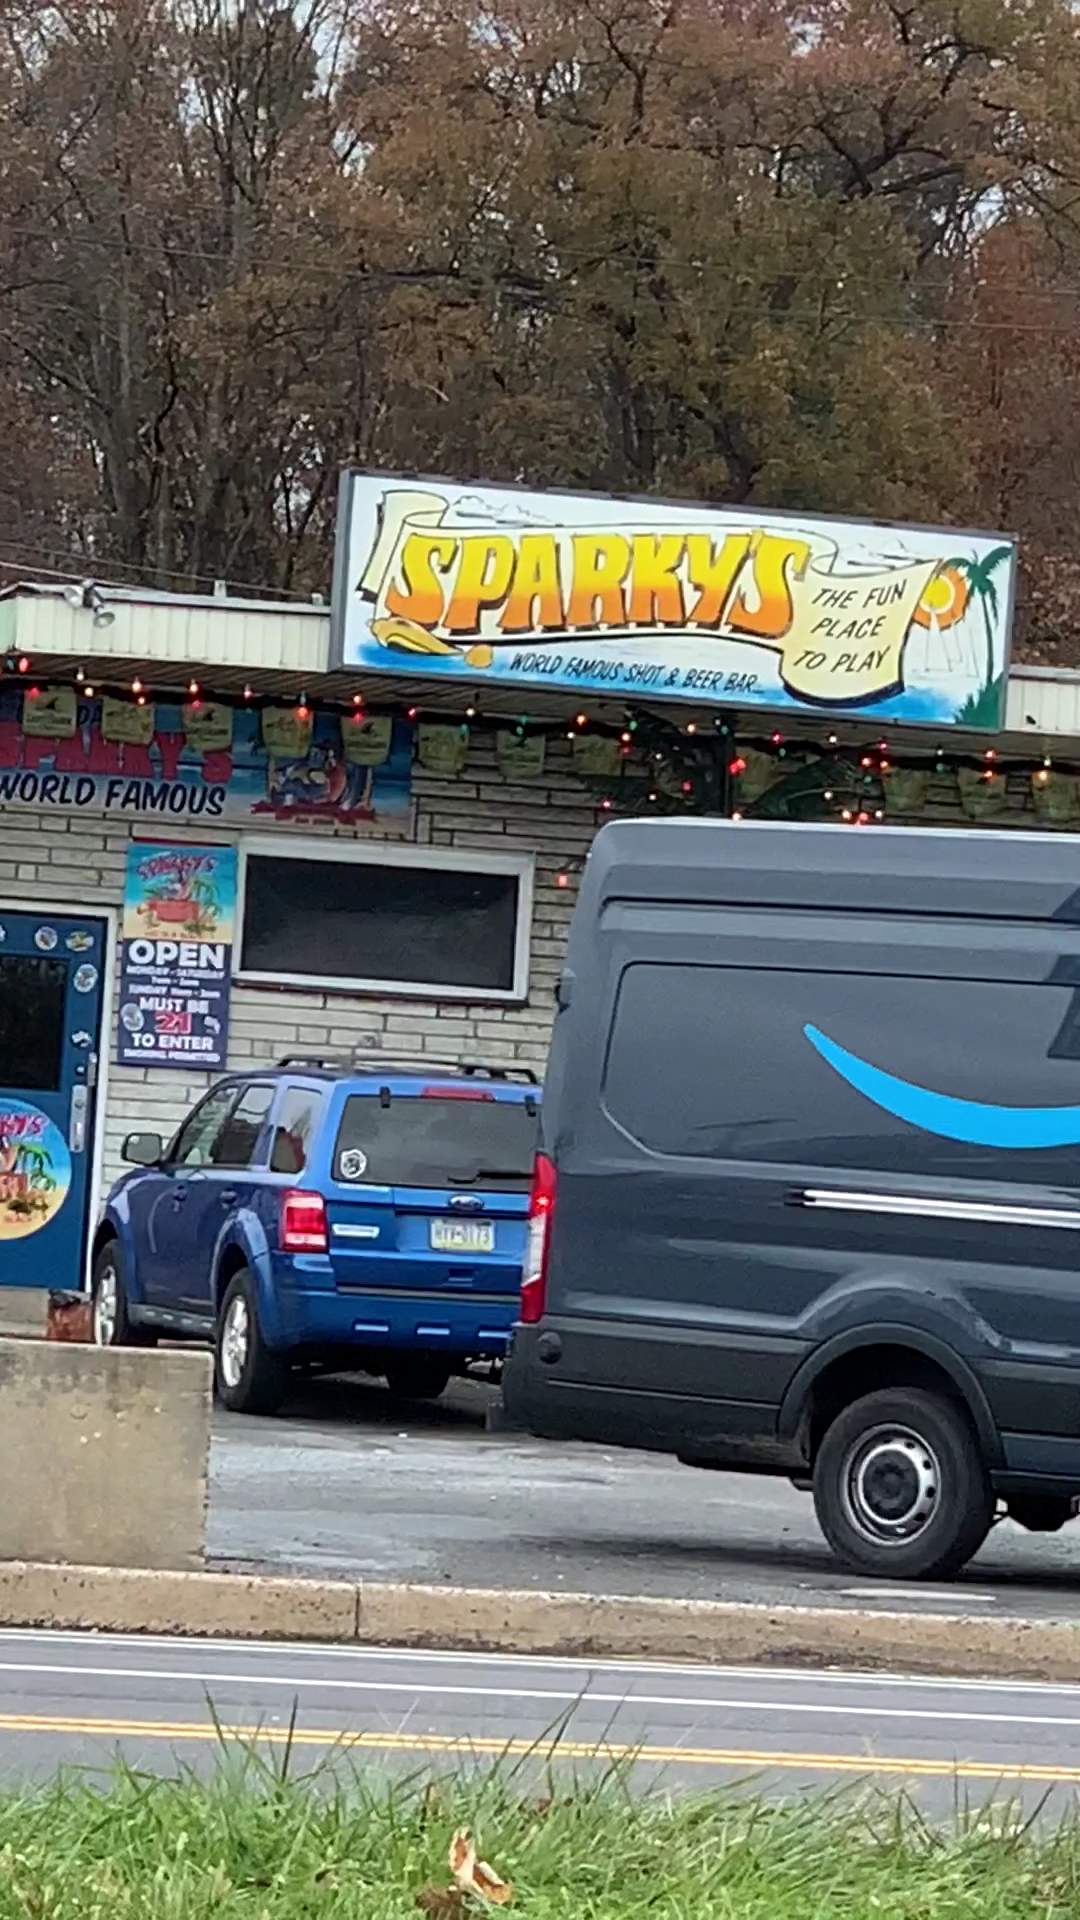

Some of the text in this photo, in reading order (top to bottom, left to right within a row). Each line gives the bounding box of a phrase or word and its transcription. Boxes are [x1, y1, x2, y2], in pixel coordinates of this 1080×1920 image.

[385, 529, 811, 640] SPARKY'S
[811, 578, 908, 610] THE FUN
[811, 615, 887, 639] PLACE
[509, 651, 558, 675] WORLD
[562, 657, 622, 682] FAMOUS
[623, 664, 663, 685] SHOT
[663, 671, 679, 686] &
[681, 668, 720, 692] BEER
[792, 646, 891, 673] TO PLAY
[0, 773, 227, 816] WORLD FAMOUS
[128, 938, 224, 969] OPEN
[140, 997, 209, 1014] MUST BE
[154, 1011, 193, 1035] 21
[131, 1033, 214, 1051] TO ENTER
